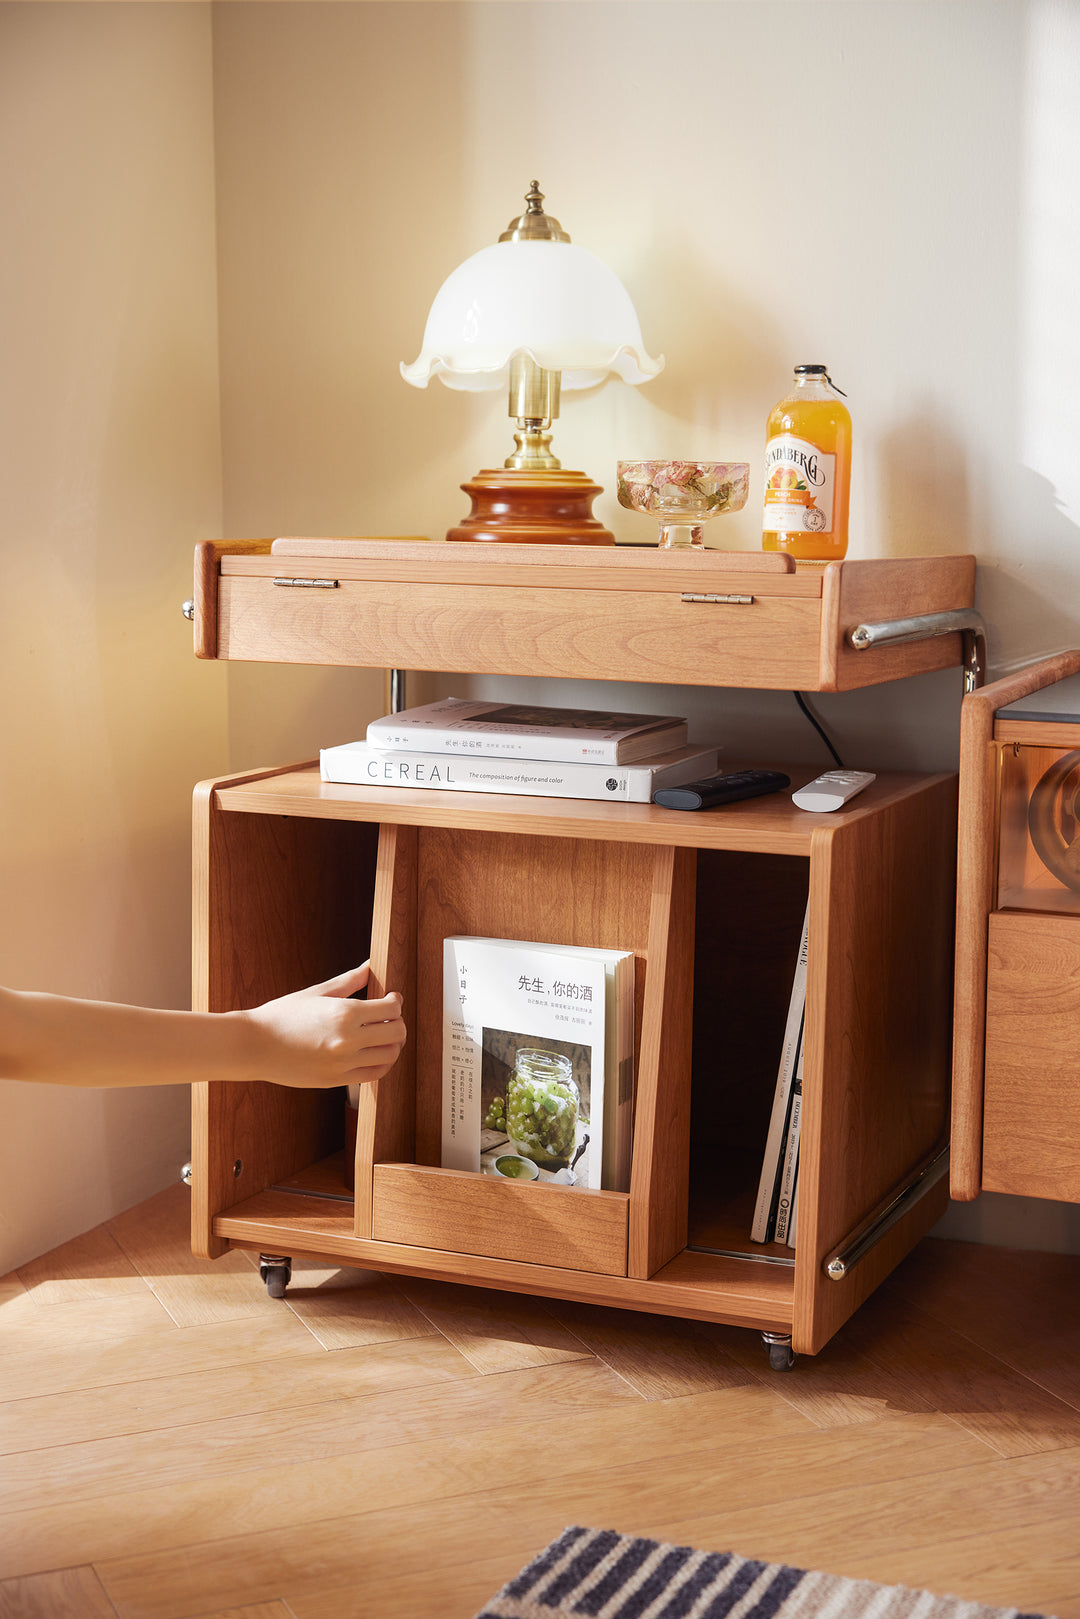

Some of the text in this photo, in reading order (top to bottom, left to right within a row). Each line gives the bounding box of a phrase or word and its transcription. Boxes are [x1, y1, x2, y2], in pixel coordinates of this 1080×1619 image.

[367, 761, 456, 783] CEREAL
[479, 773, 513, 781] composition
[520, 774, 538, 783] figure
[459, 965, 468, 1004] 小日子
